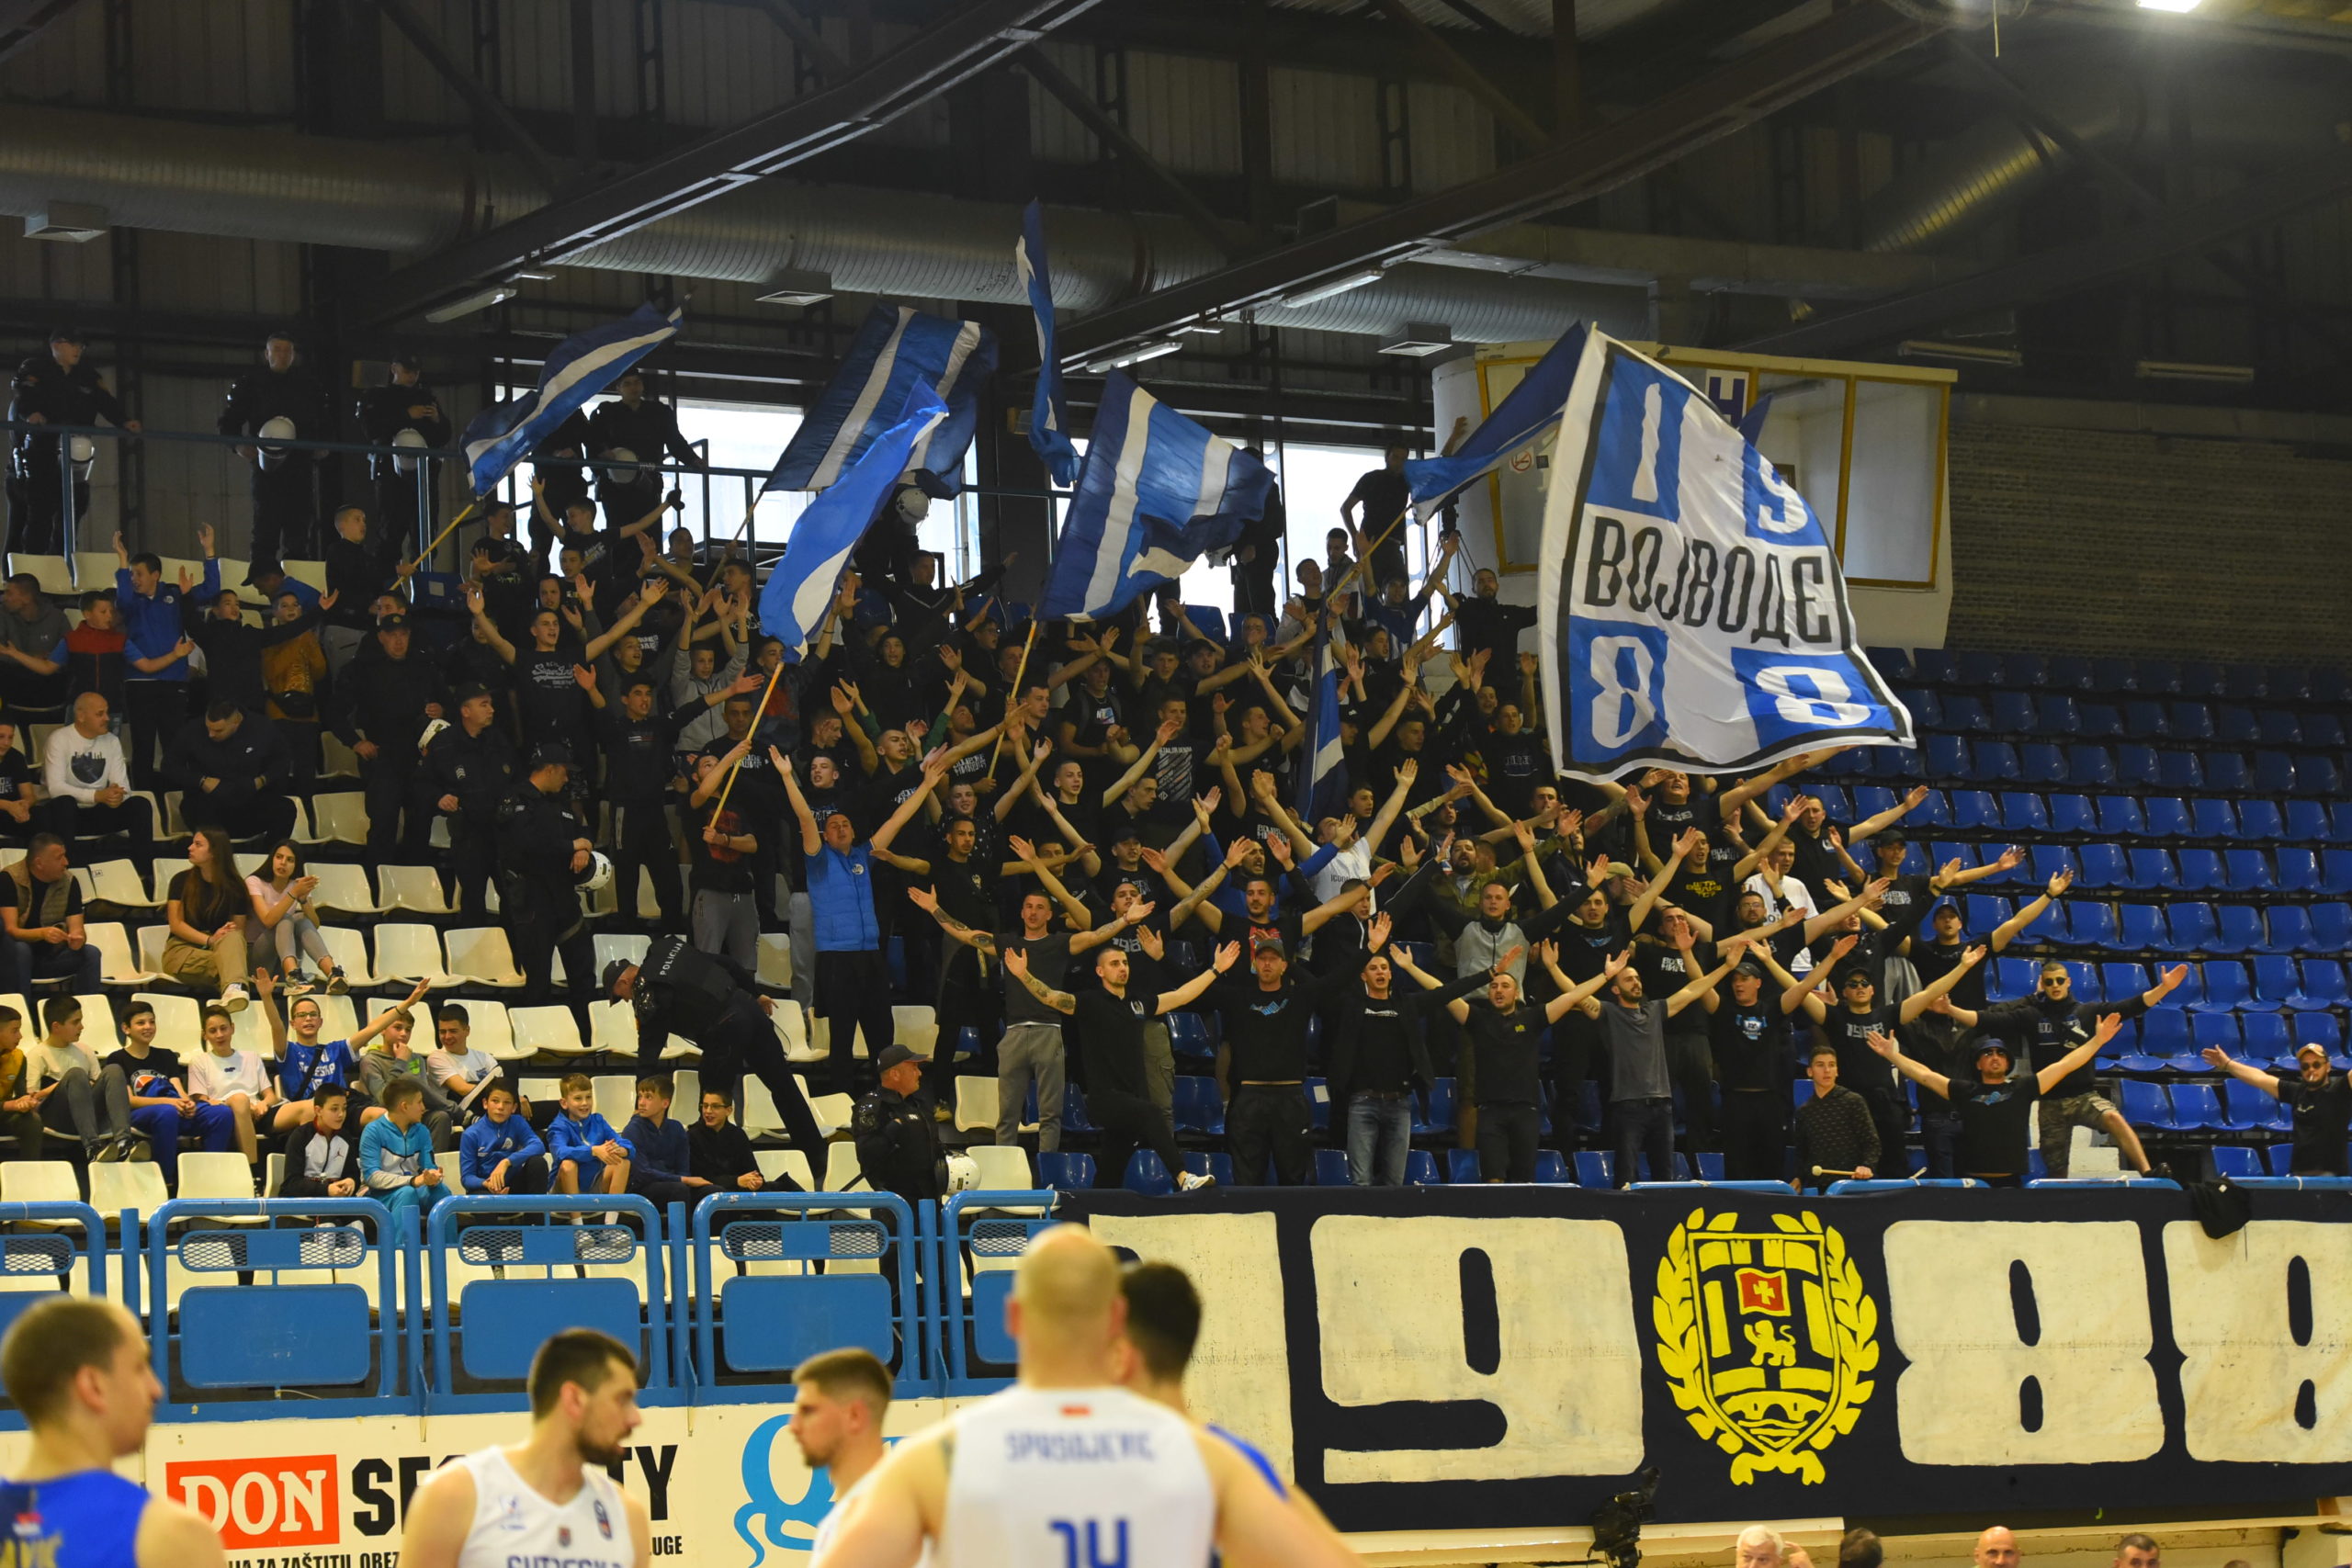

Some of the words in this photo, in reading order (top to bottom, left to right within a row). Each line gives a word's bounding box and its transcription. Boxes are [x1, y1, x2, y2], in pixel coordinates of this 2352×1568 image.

[1585, 516, 1832, 647] ВОЈВОДЕ
[659, 942, 684, 976] POLICIJA
[1112, 937, 1142, 953] 198
[179, 1470, 327, 1536] DON
[650, 1536, 683, 1556] UGE
